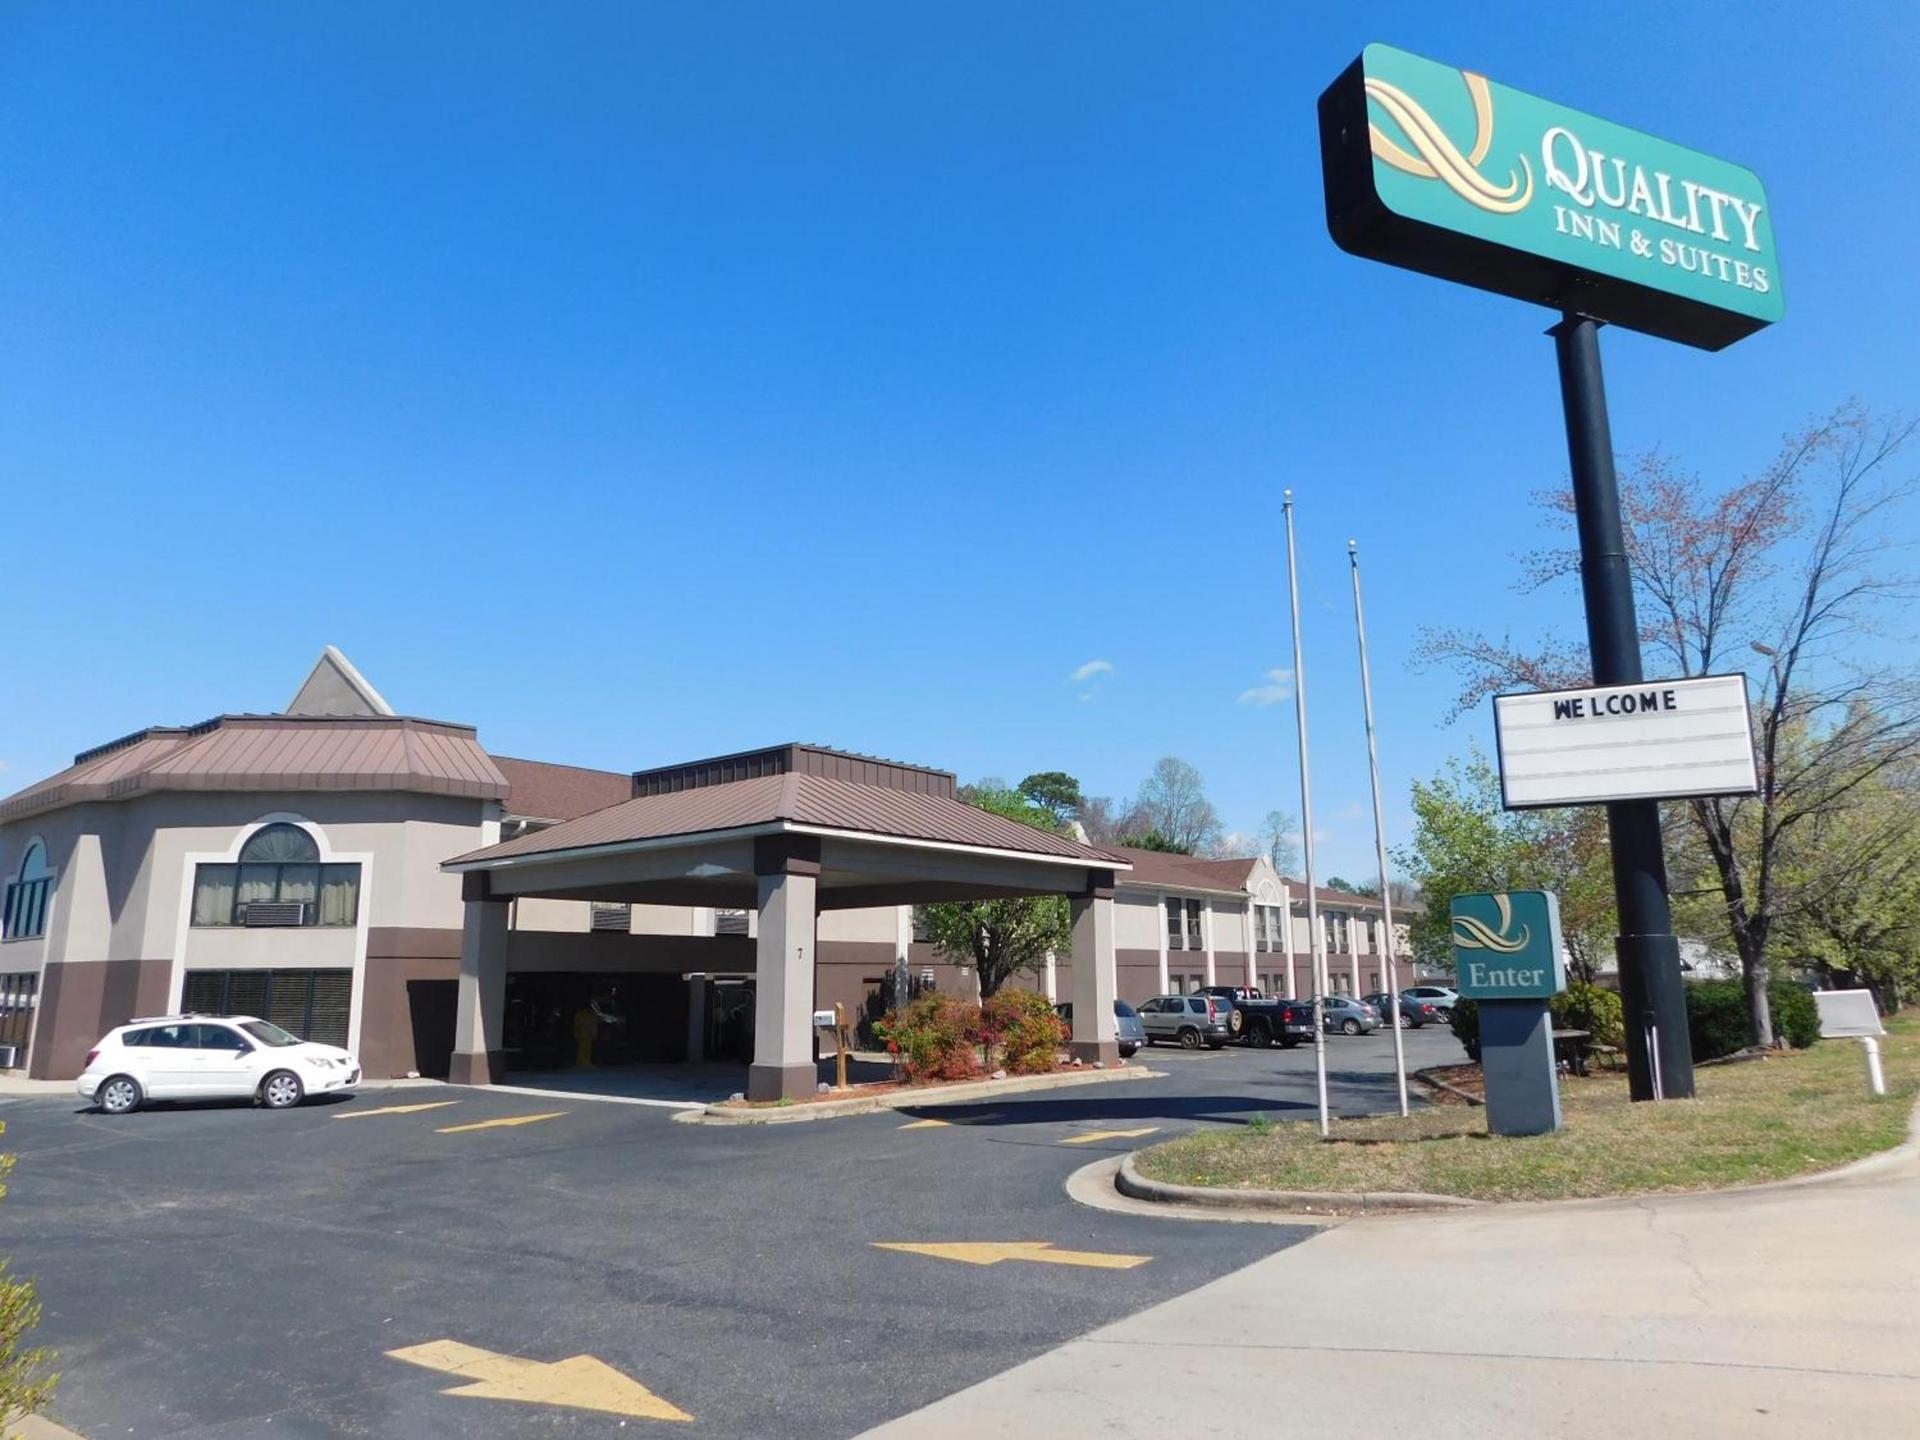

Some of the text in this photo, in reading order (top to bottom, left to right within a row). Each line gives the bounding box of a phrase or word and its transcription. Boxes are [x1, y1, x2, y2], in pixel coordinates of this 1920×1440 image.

[1542, 127, 1761, 251] QUALITY
[1553, 205, 1769, 293] INN & SUITES
[1554, 690, 1677, 720] WELCOME
[1468, 963, 1544, 987] Enter
